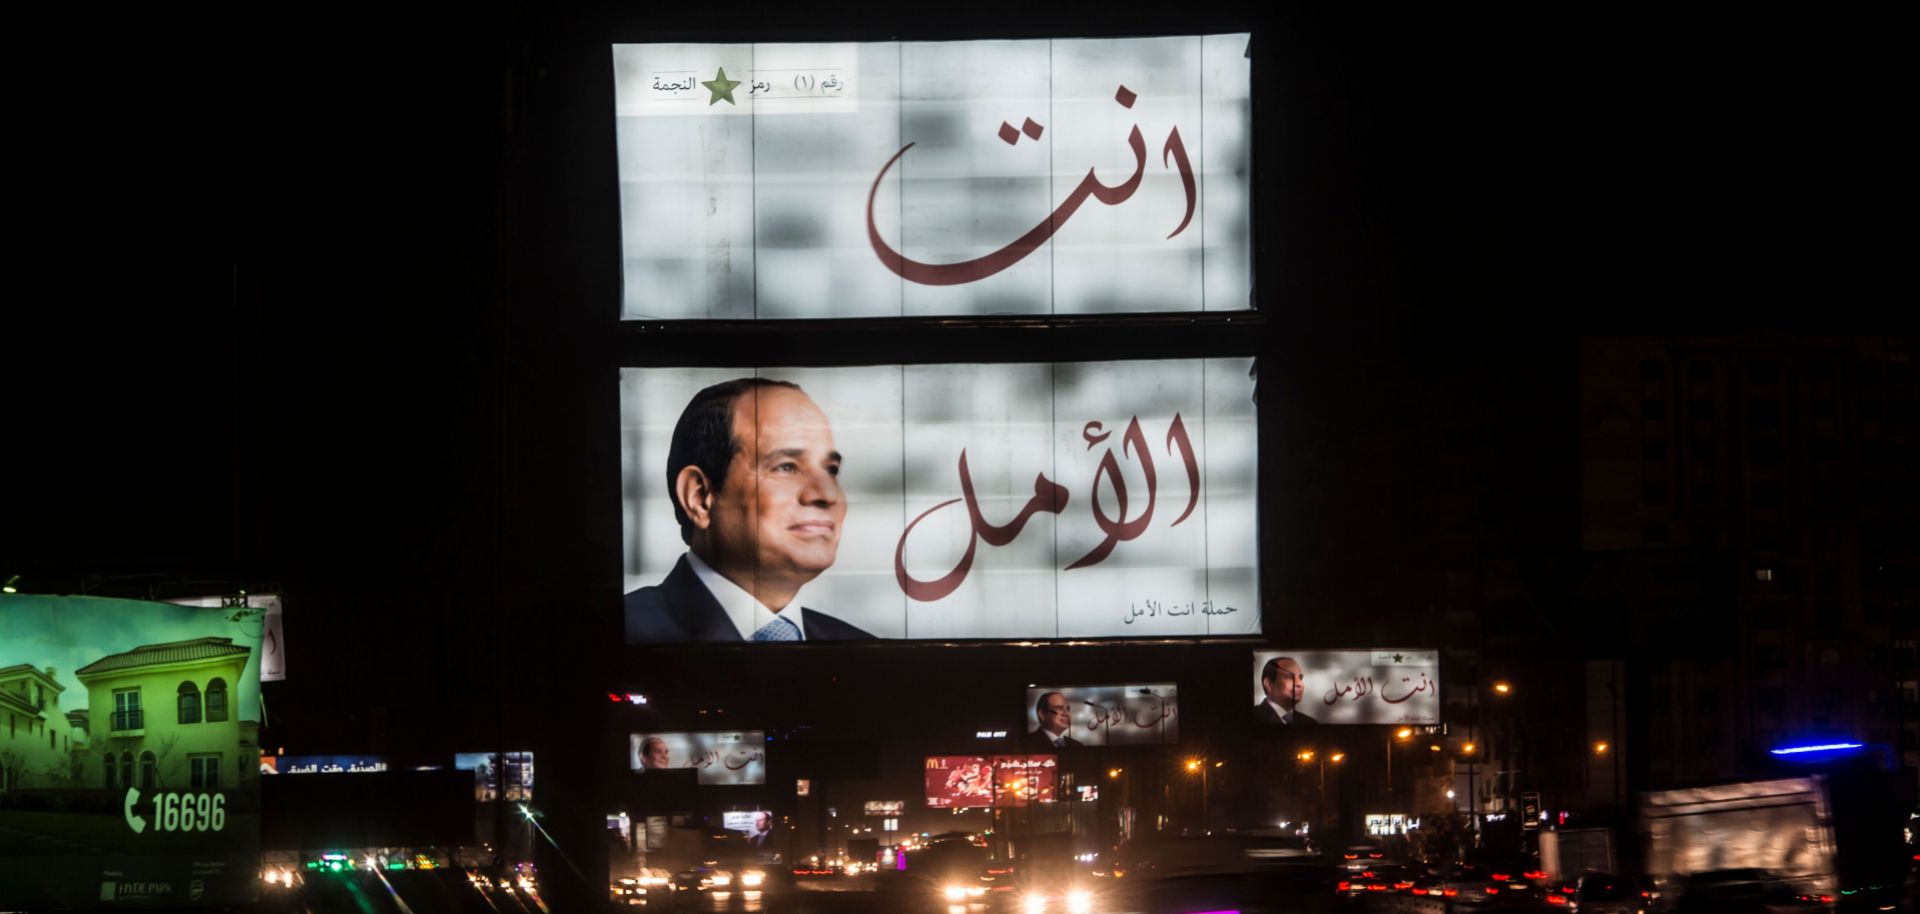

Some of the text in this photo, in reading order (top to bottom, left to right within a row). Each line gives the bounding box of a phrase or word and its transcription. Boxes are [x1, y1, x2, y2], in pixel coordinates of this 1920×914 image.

[652, 76, 696, 94] النجمة
[749, 78, 770, 94] رمز
[821, 74, 844, 94] رقم
[866, 84, 1197, 286] انت
[895, 412, 1200, 602] الأمل
[1124, 600, 1238, 624] حملة انت الأمل
[1381, 672, 1435, 704] انت
[152, 793, 226, 832] 16696
[118, 882, 146, 895] HYDE
